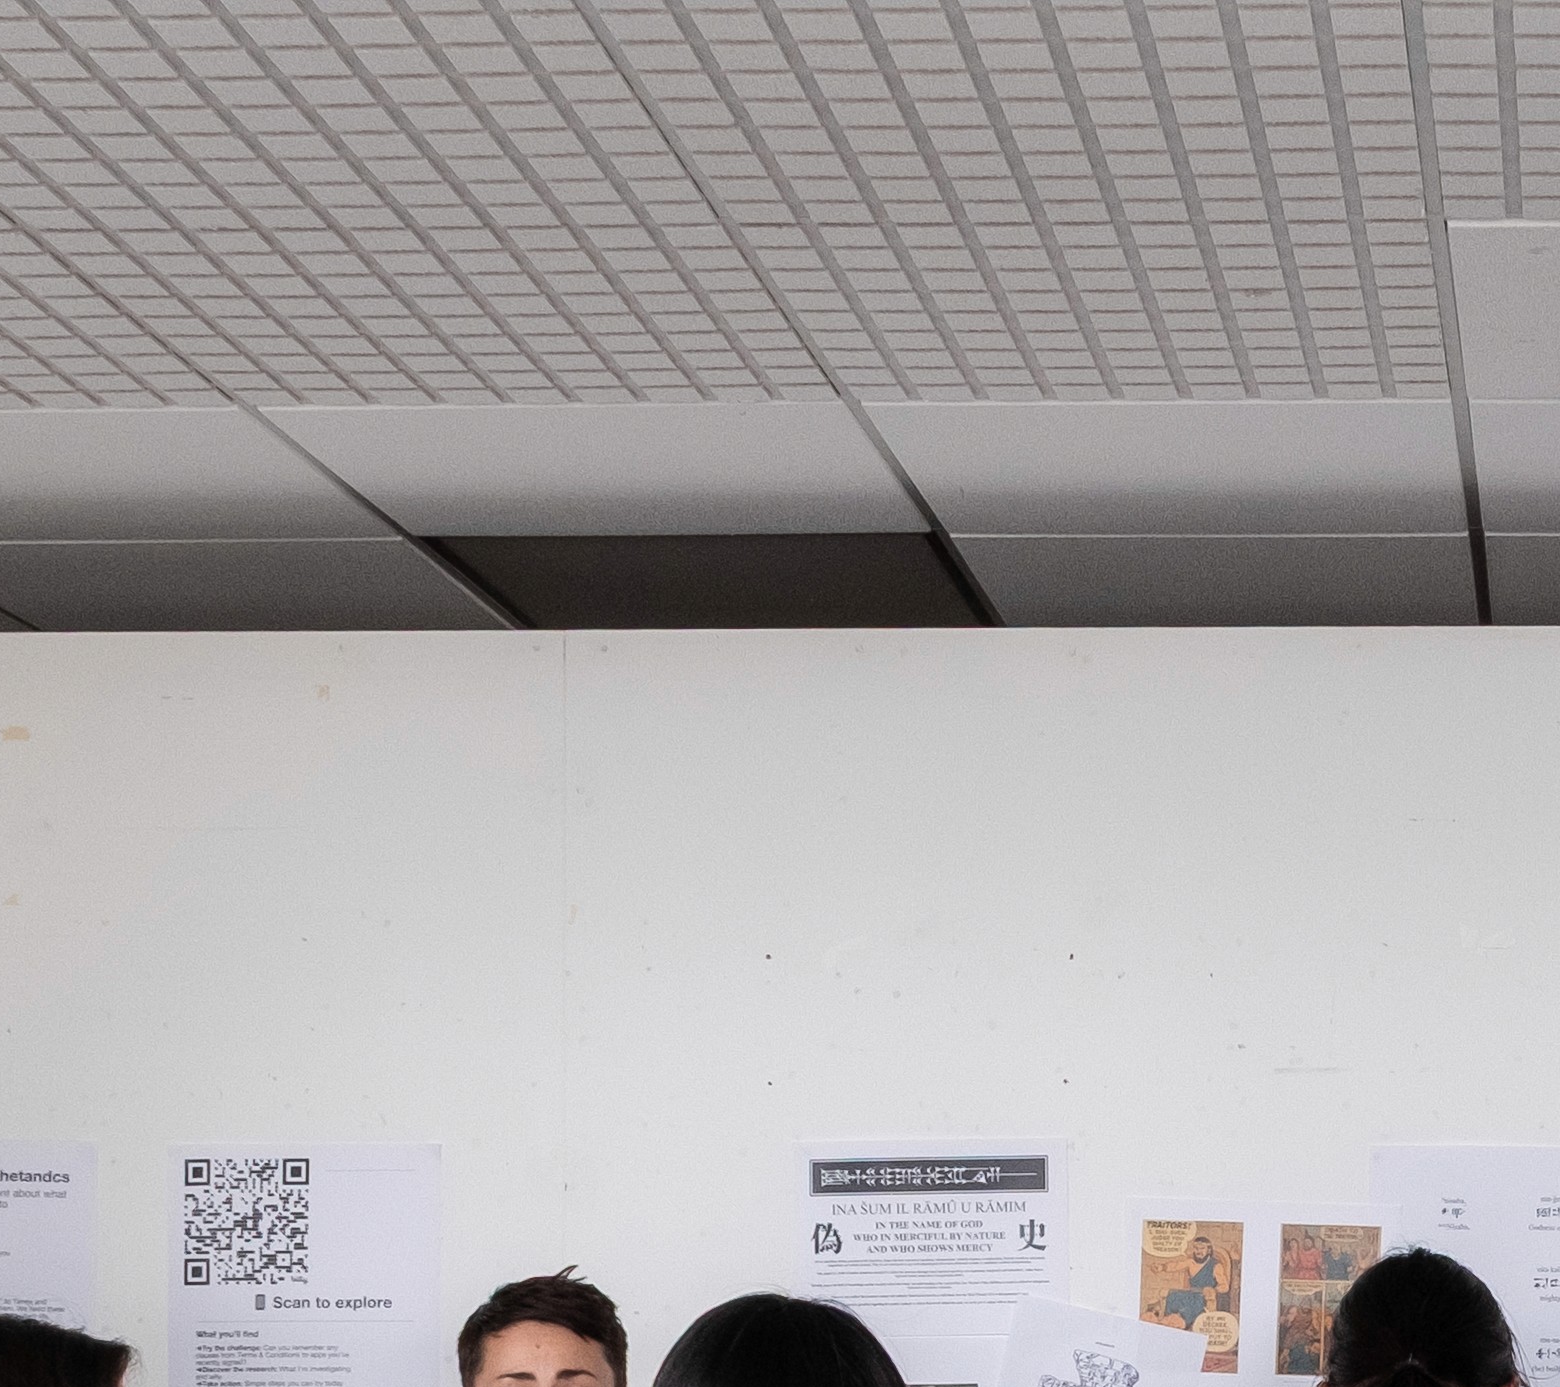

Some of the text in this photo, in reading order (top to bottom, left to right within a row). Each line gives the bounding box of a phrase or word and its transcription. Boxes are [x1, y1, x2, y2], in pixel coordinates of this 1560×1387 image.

[13, 1189, 40, 1198] about
[832, 1204, 857, 1216] INA
[860, 1199, 892, 1216] ŠUM
[896, 1203, 909, 1214] IL
[960, 1202, 972, 1213] U
[875, 1220, 983, 1229] IN THE NAME OF GOD
[853, 1233, 877, 1241] WHO
[895, 1232, 947, 1241] MERCIFUL
[949, 1232, 962, 1240] BY
[965, 1231, 1006, 1240] NATURE
[1019, 1219, 1047, 1251] 史
[867, 1243, 993, 1254] AND WHO SHOWS MERCY
[273, 1296, 392, 1311] Scan to explore
